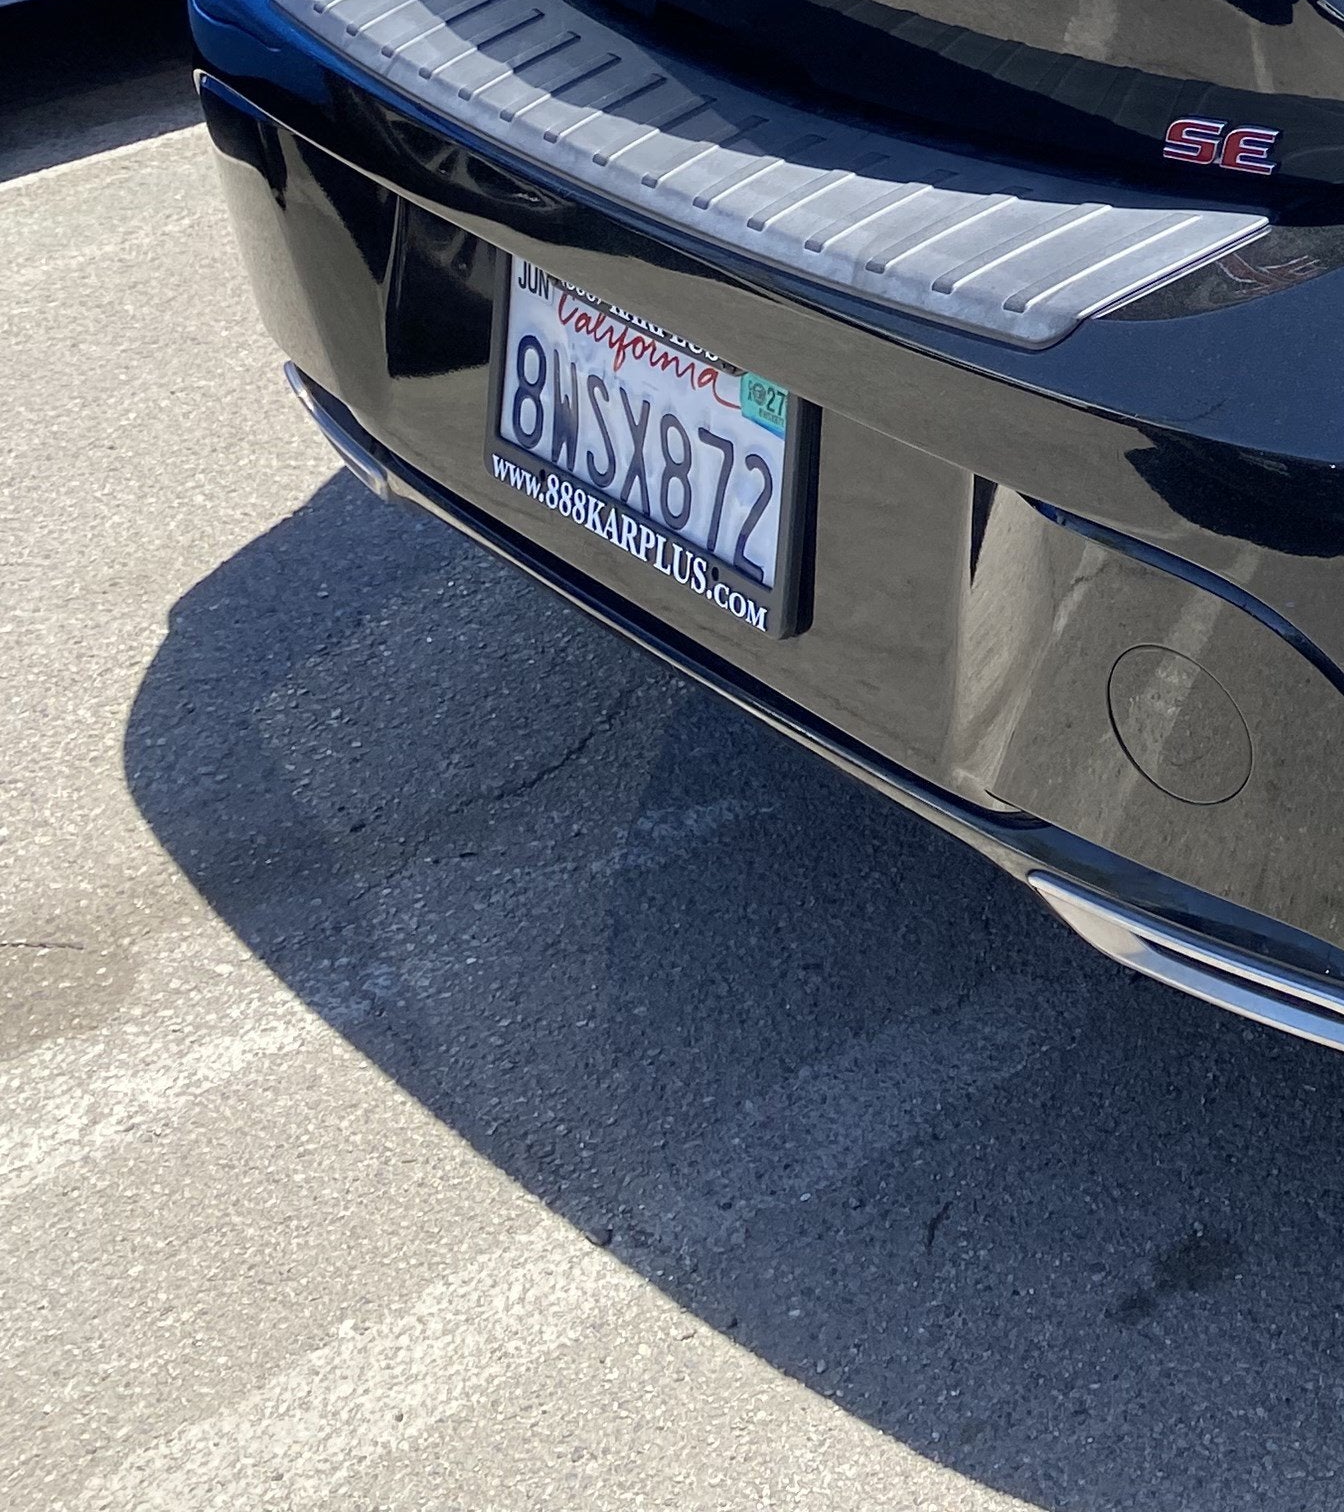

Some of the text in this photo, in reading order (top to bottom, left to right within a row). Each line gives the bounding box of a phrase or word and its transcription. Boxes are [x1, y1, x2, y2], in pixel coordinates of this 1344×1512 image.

[1163, 116, 1279, 176] SE
[517, 260, 550, 300] JUN
[558, 290, 743, 410] California
[766, 386, 786, 417] 27
[511, 334, 774, 592] 8WSX872
